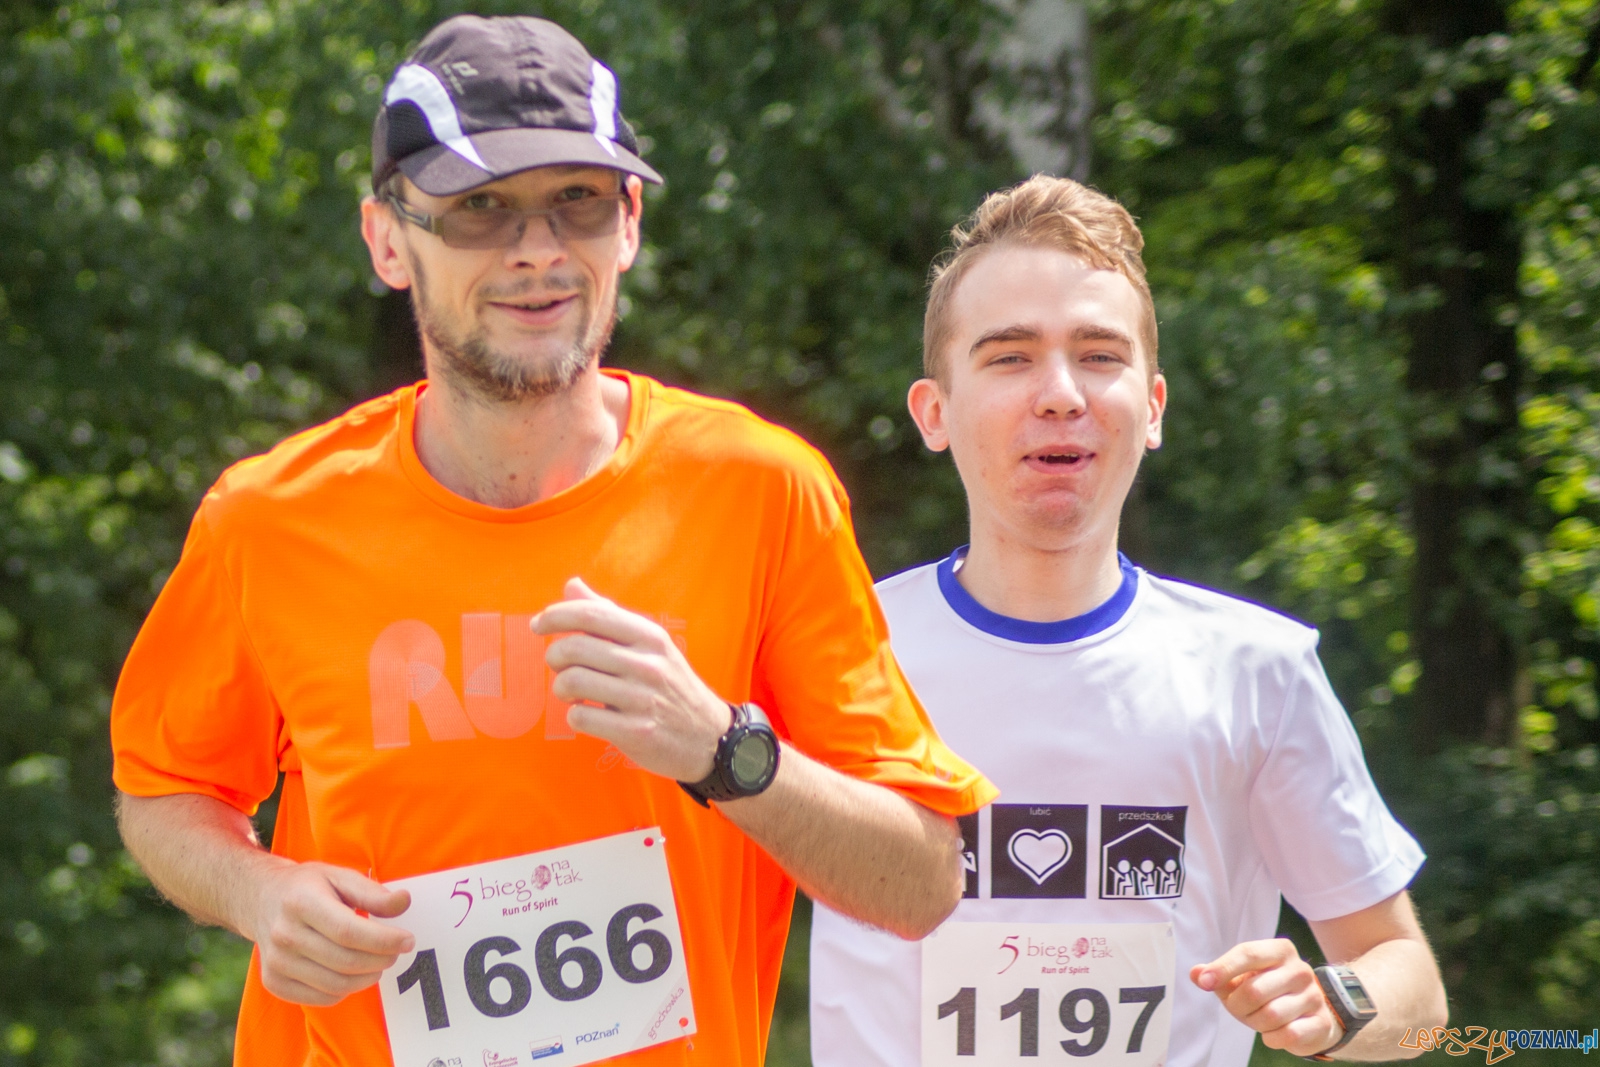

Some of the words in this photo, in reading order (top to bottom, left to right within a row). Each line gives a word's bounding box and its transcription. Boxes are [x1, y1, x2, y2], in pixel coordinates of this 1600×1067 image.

[1029, 806, 1052, 816] lubić
[1118, 811, 1175, 823] przedszkole
[550, 859, 570, 872] na
[554, 869, 583, 887] tak
[450, 878, 474, 928] 5
[480, 877, 532, 902] bieg
[502, 906, 520, 917] Run
[522, 902, 532, 913] of
[533, 897, 558, 912] Spirit
[1090, 937, 1106, 946] na
[997, 935, 1020, 975] 5
[1027, 937, 1071, 964] bieg
[1092, 946, 1114, 959] tak
[396, 902, 673, 1031] 1666
[1041, 966, 1057, 974] Run
[1058, 966, 1067, 974] of
[1068, 966, 1090, 975] Spirit
[937, 985, 1166, 1057] 1197
